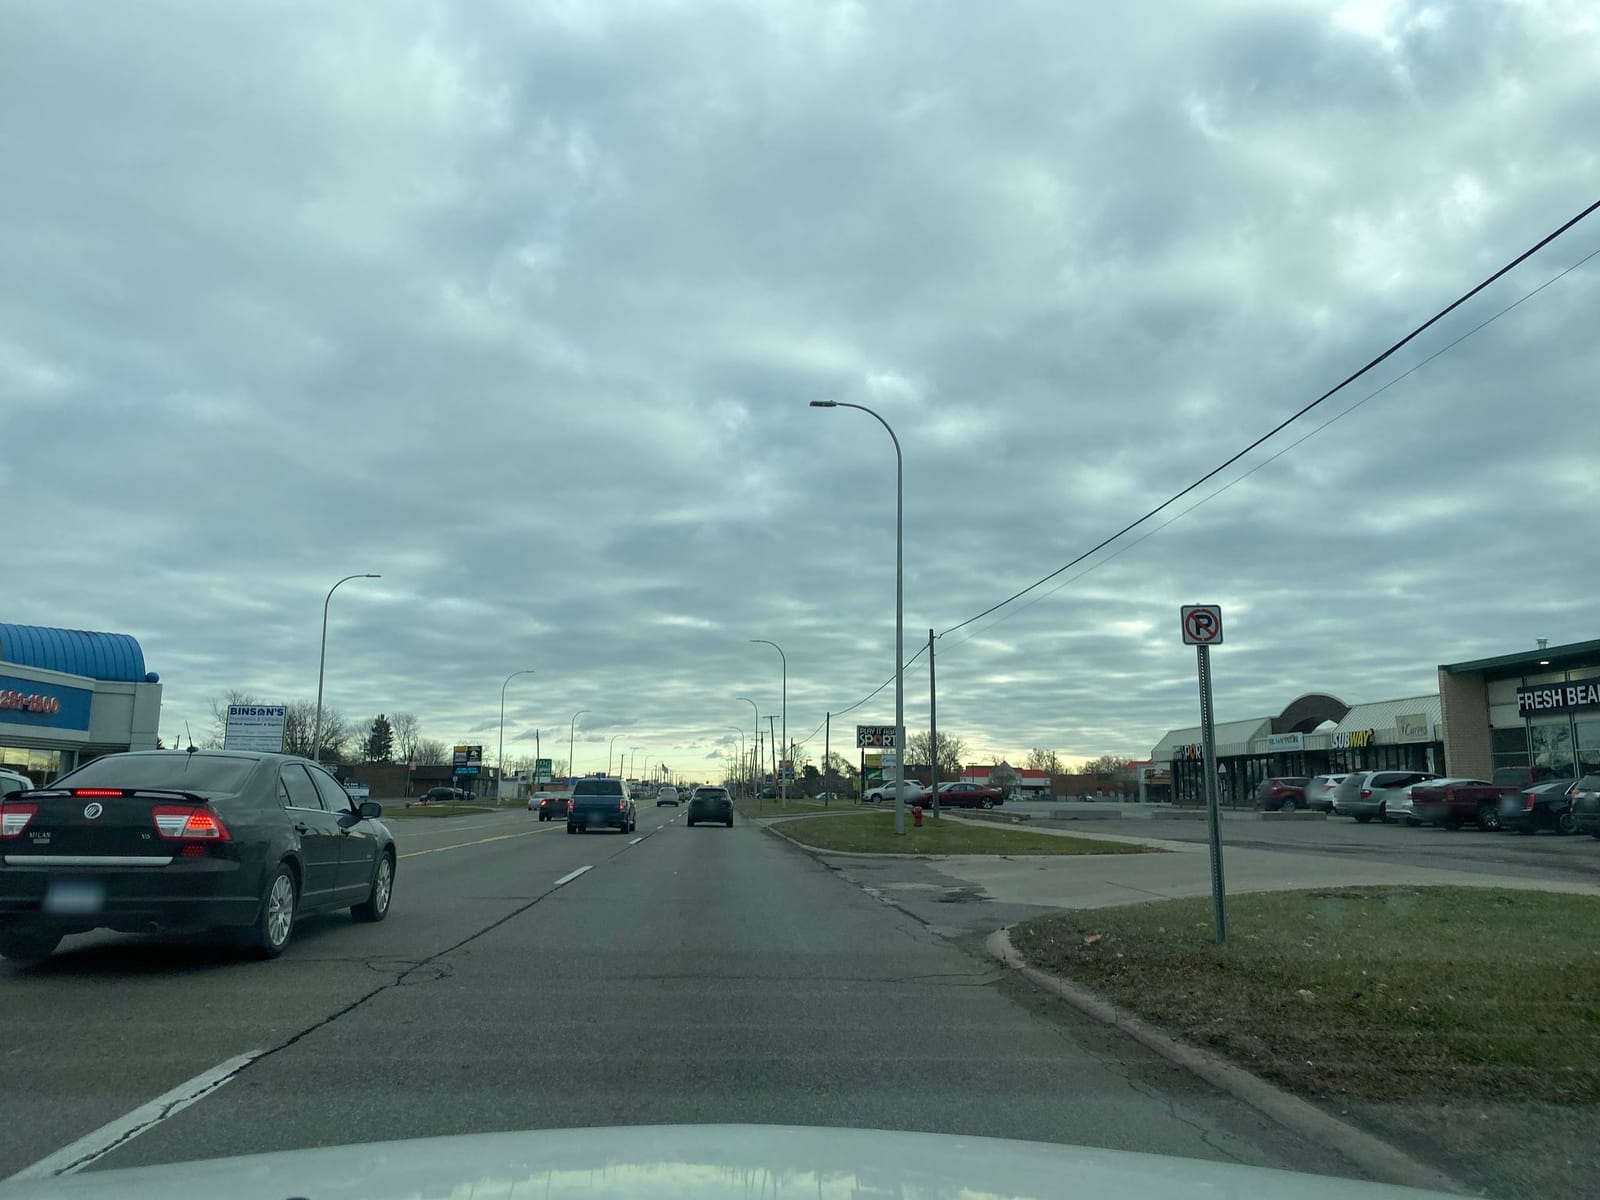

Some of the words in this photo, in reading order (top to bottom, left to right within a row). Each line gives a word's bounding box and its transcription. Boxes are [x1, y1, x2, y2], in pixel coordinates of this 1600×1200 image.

[1517, 688, 1563, 710] FRESH
[230, 707, 284, 716] BINSON'S
[860, 727, 875, 735] PLAY
[859, 734, 897, 746] SPORT
[1333, 728, 1374, 748] SUBWAY
